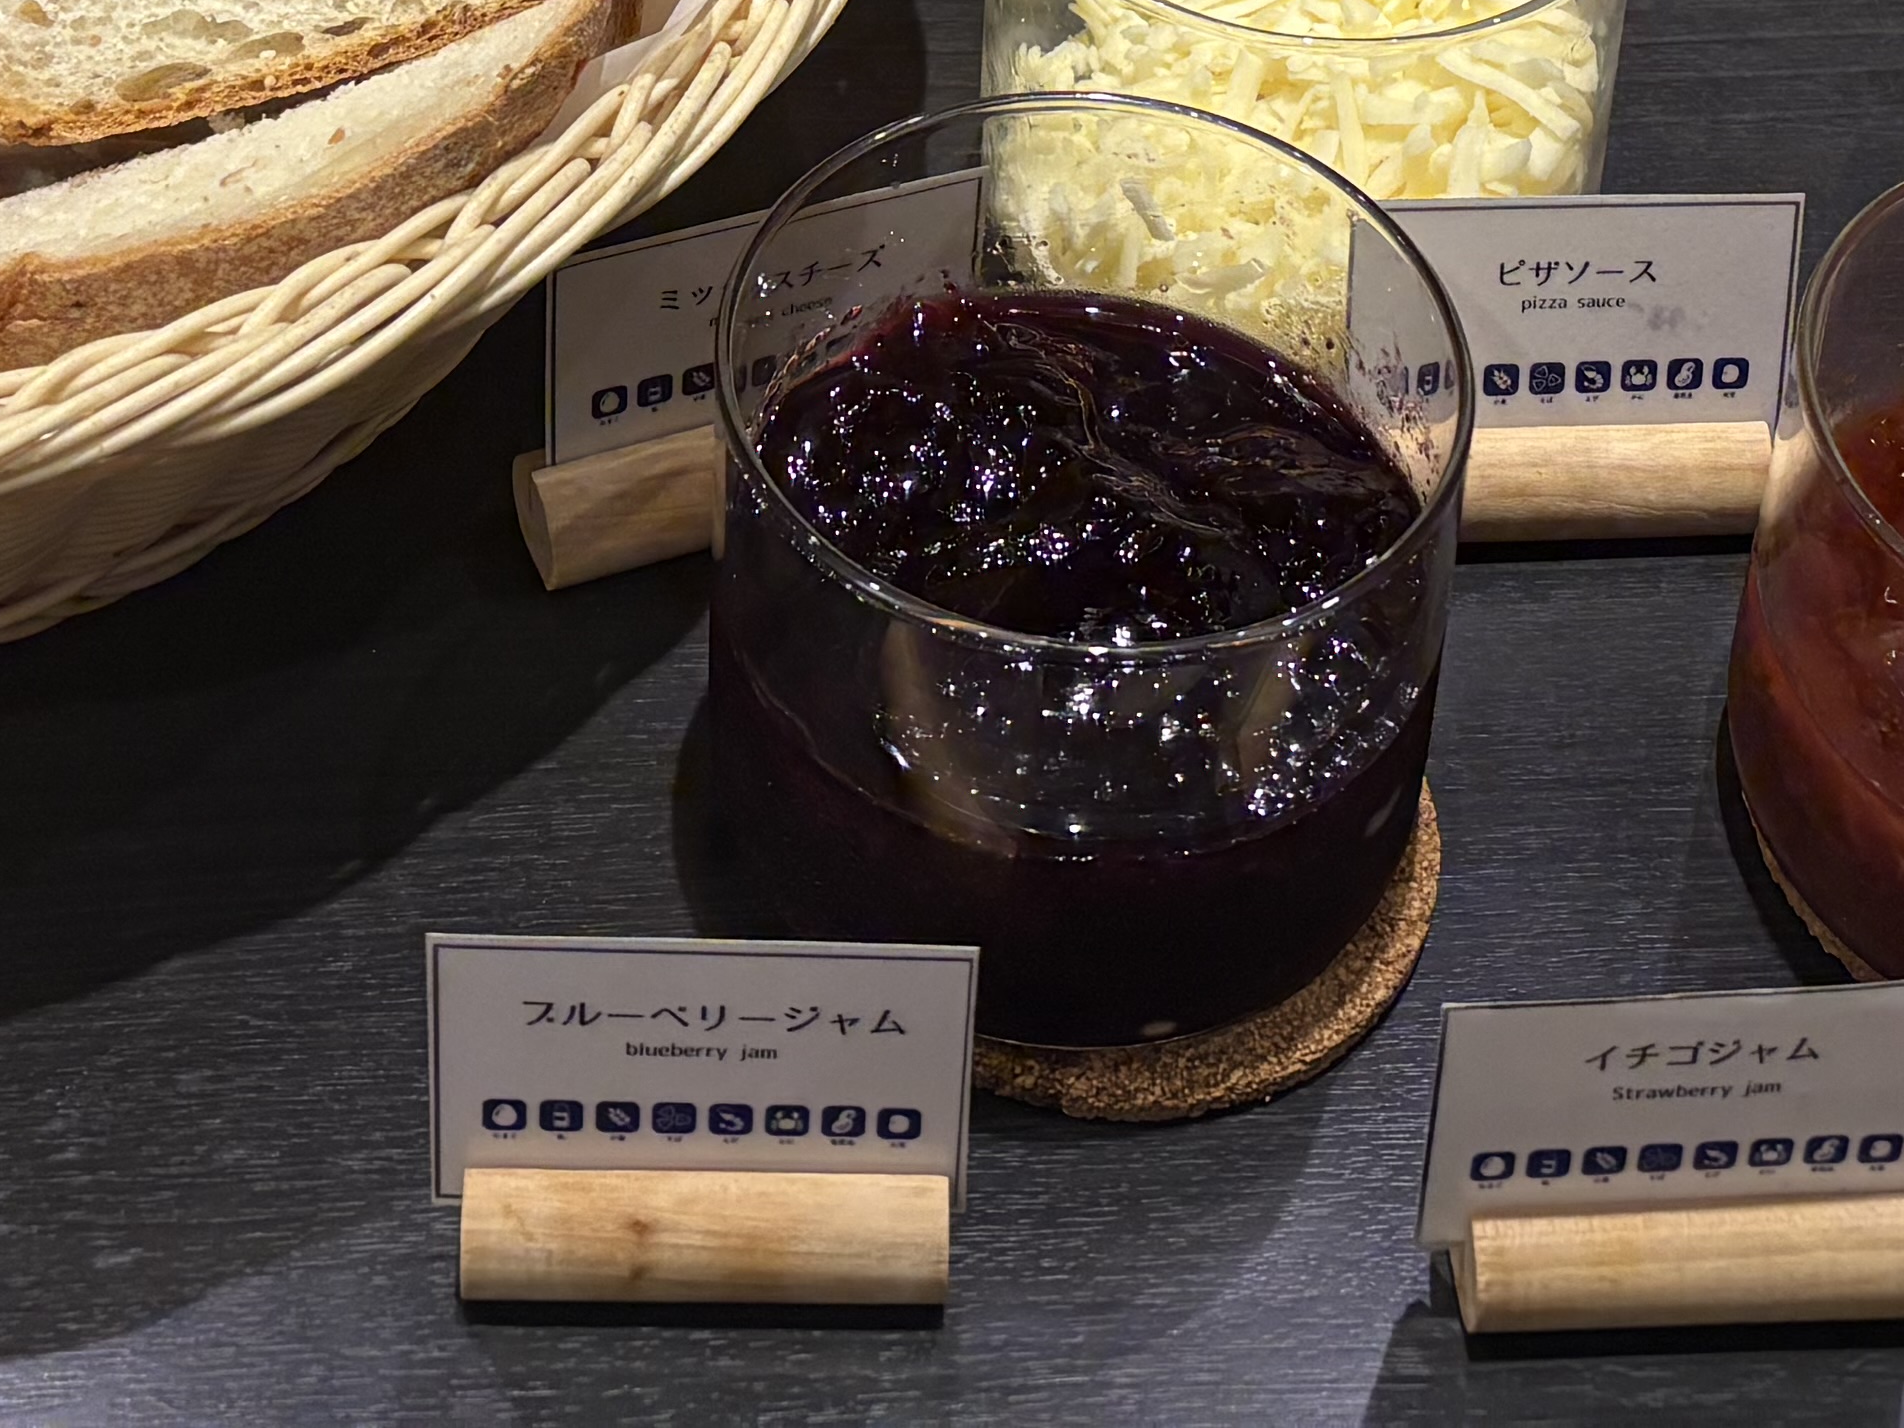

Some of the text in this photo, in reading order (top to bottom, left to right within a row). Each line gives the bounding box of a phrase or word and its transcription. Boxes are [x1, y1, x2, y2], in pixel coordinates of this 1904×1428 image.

[660, 243, 885, 311] ミッスチーズ
[1498, 259, 1658, 288] ピザソース
[1521, 296, 1626, 314] pizza sauce
[625, 1042, 779, 1062] blueberry jam
[1584, 1037, 1821, 1072] イチゴジャム
[1612, 1078, 1783, 1102] Strawberry jam
